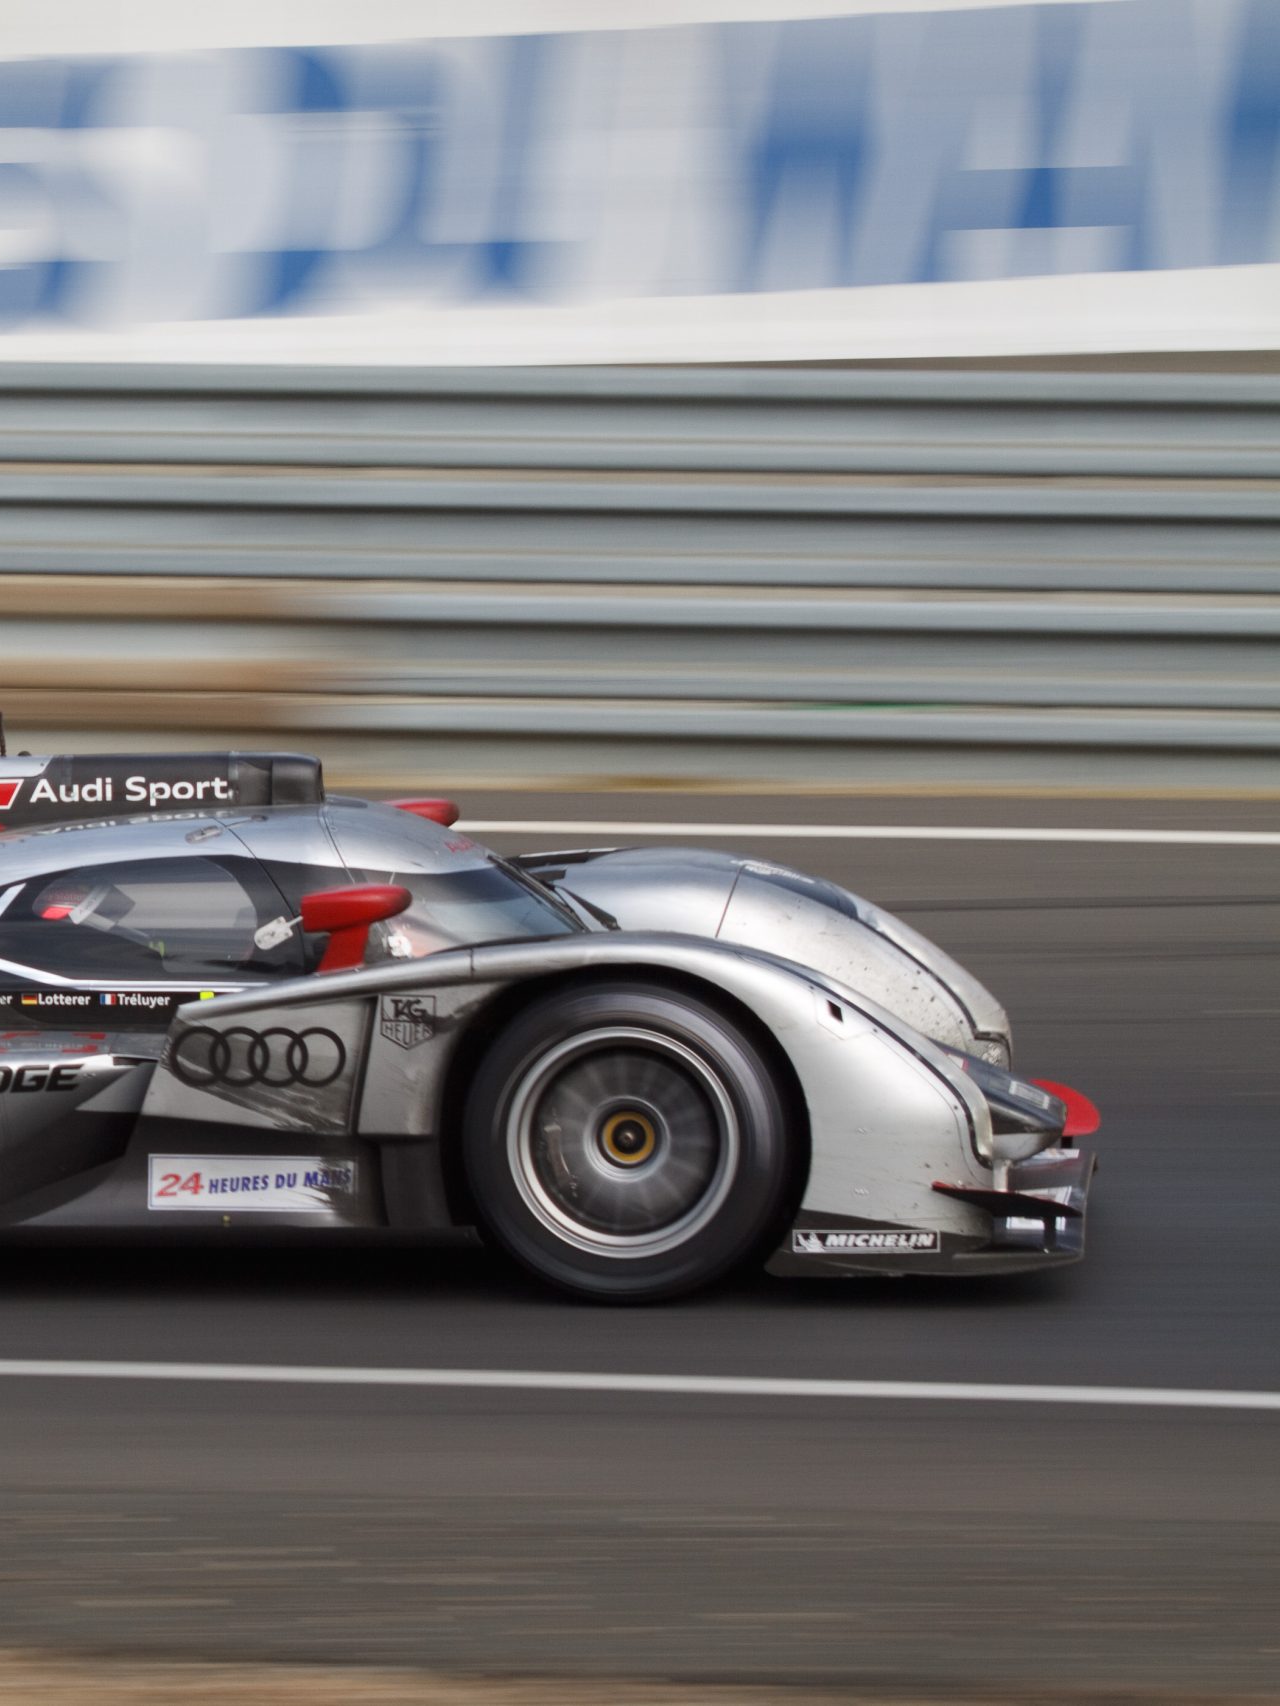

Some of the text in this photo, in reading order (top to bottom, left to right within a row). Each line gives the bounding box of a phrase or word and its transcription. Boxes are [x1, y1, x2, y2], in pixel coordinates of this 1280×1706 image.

[29, 776, 228, 806] Audi Sport
[38, 993, 90, 1006] Lotterer
[117, 992, 170, 1008] Tréluyer
[155, 1168, 352, 1197] 24 HEURES DU MANS
[825, 1232, 934, 1248] MICHELIN
